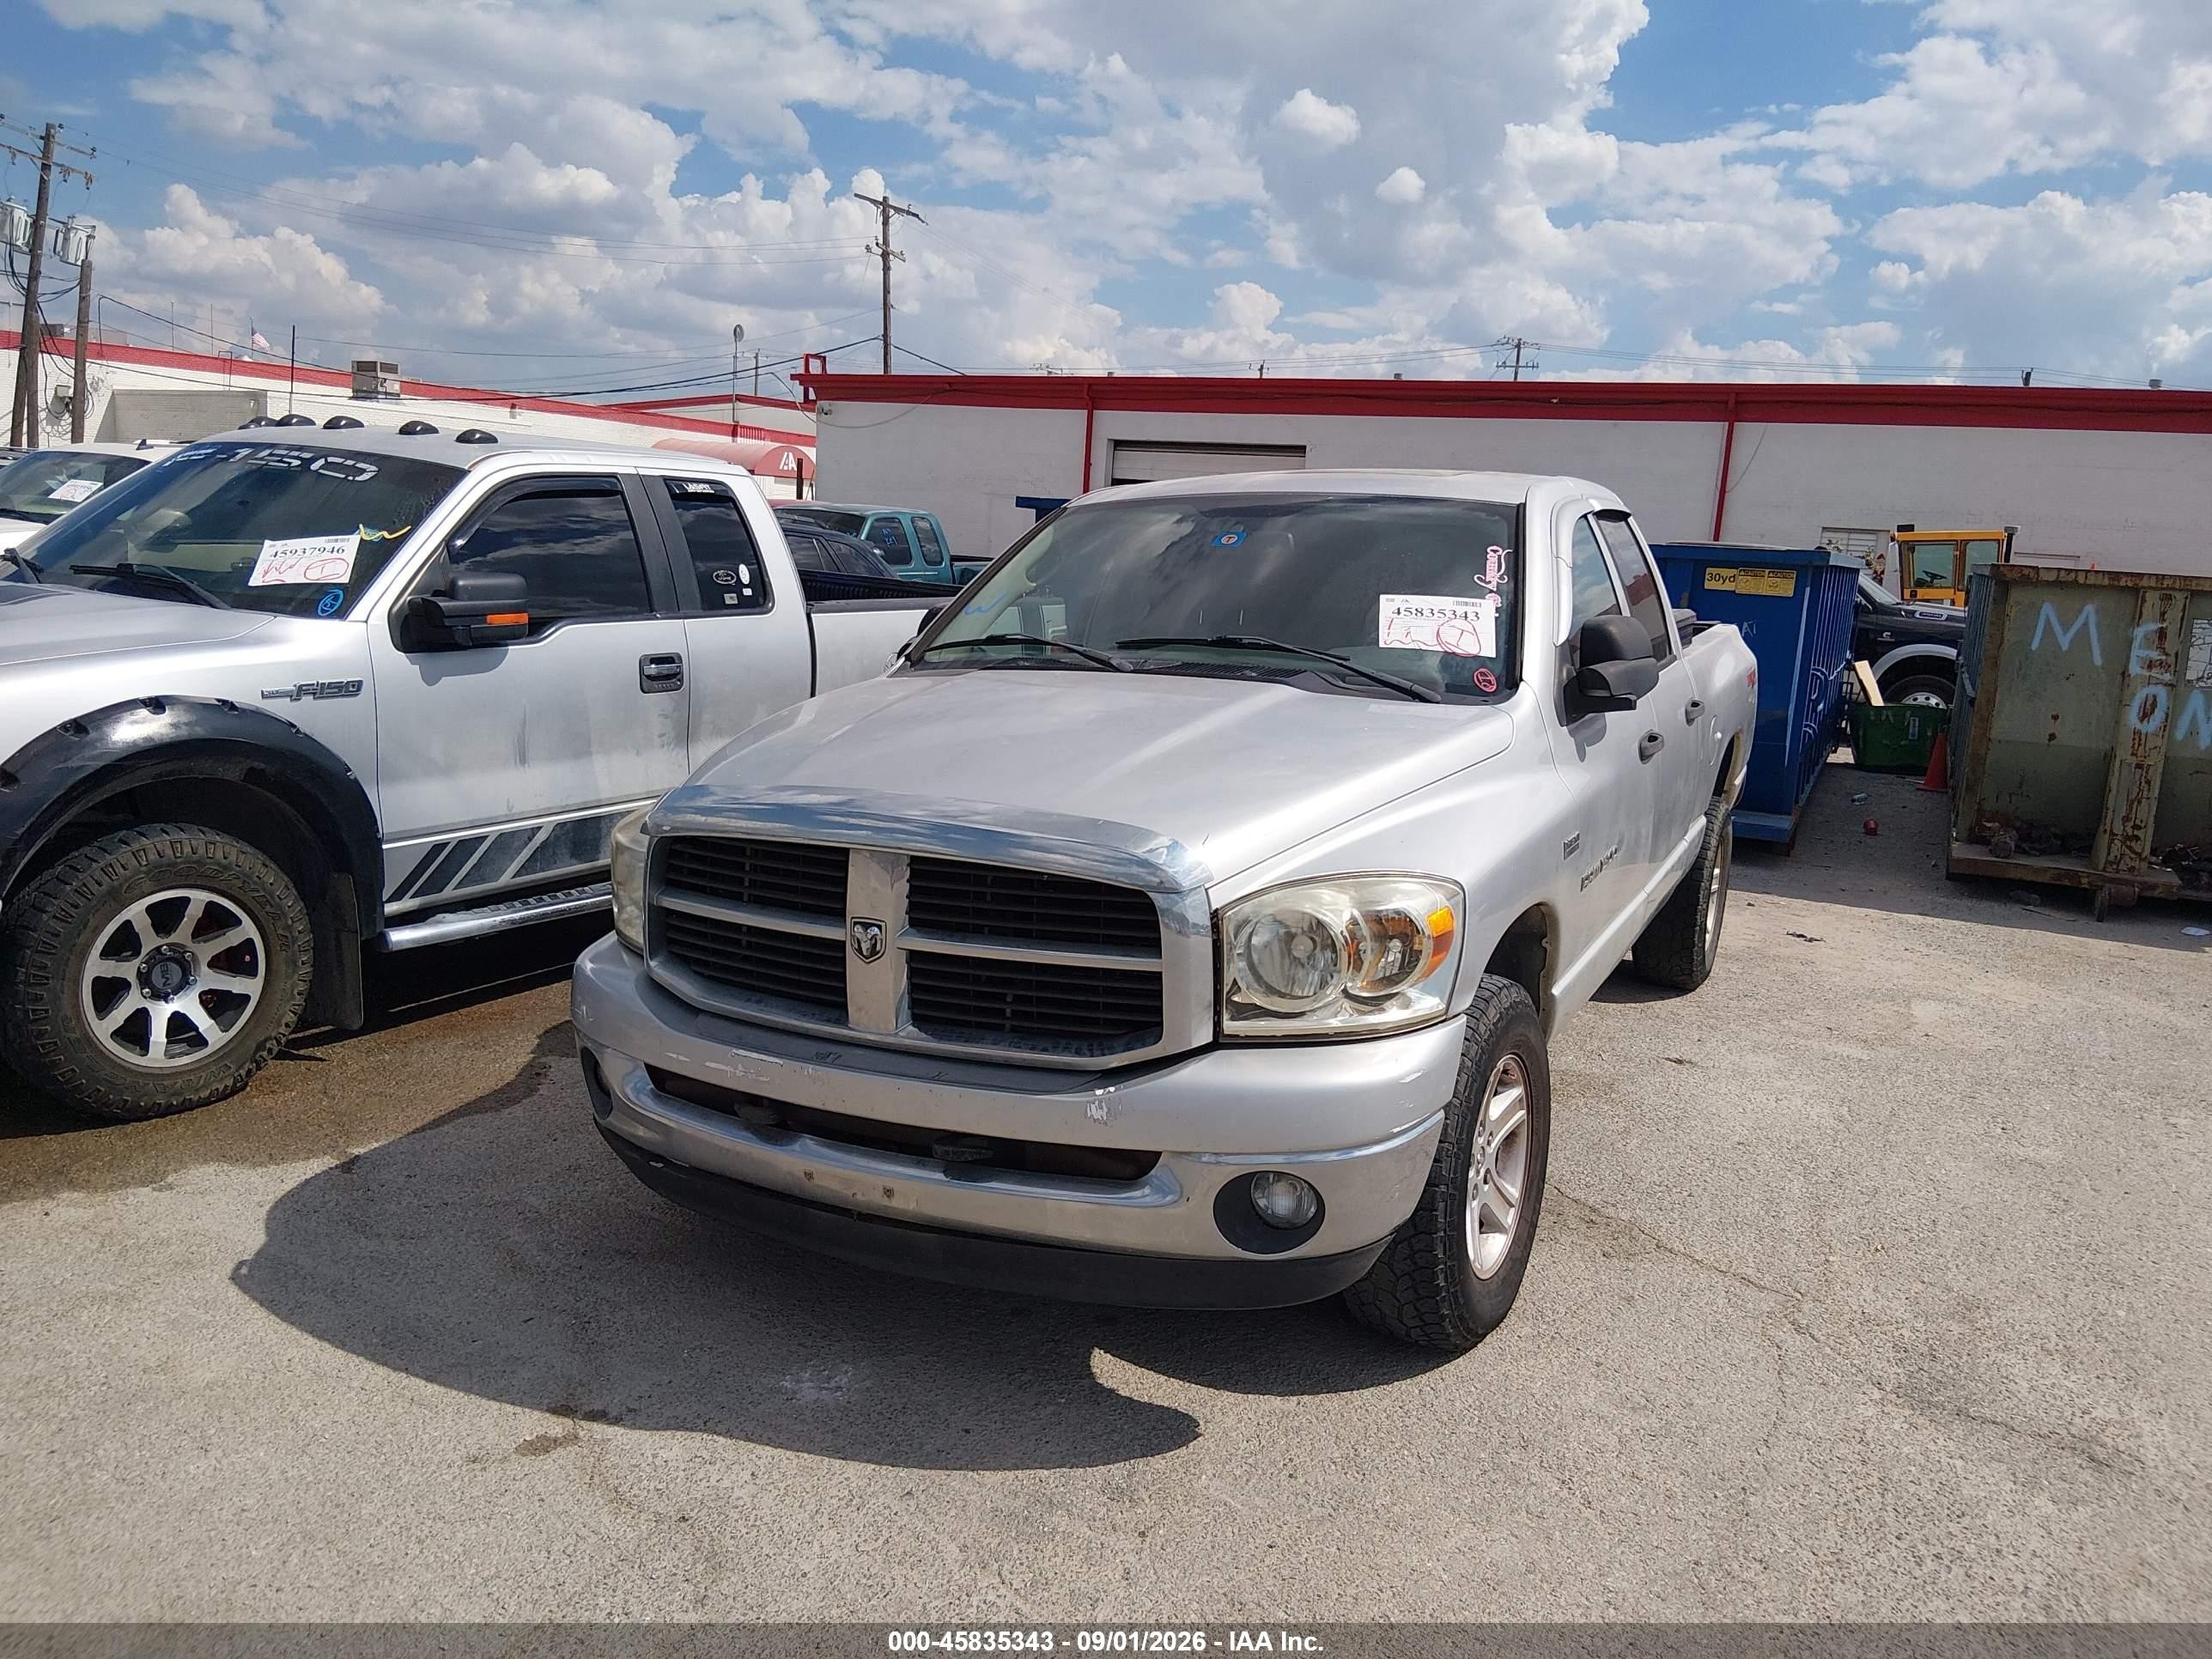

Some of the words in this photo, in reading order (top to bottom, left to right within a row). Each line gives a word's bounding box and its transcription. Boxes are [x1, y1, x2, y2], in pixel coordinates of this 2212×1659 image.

[269, 544, 346, 560] 45937946
[1706, 572, 1736, 585] 30yd
[1391, 606, 1480, 623] 45835343
[290, 678, 364, 702] F-150
